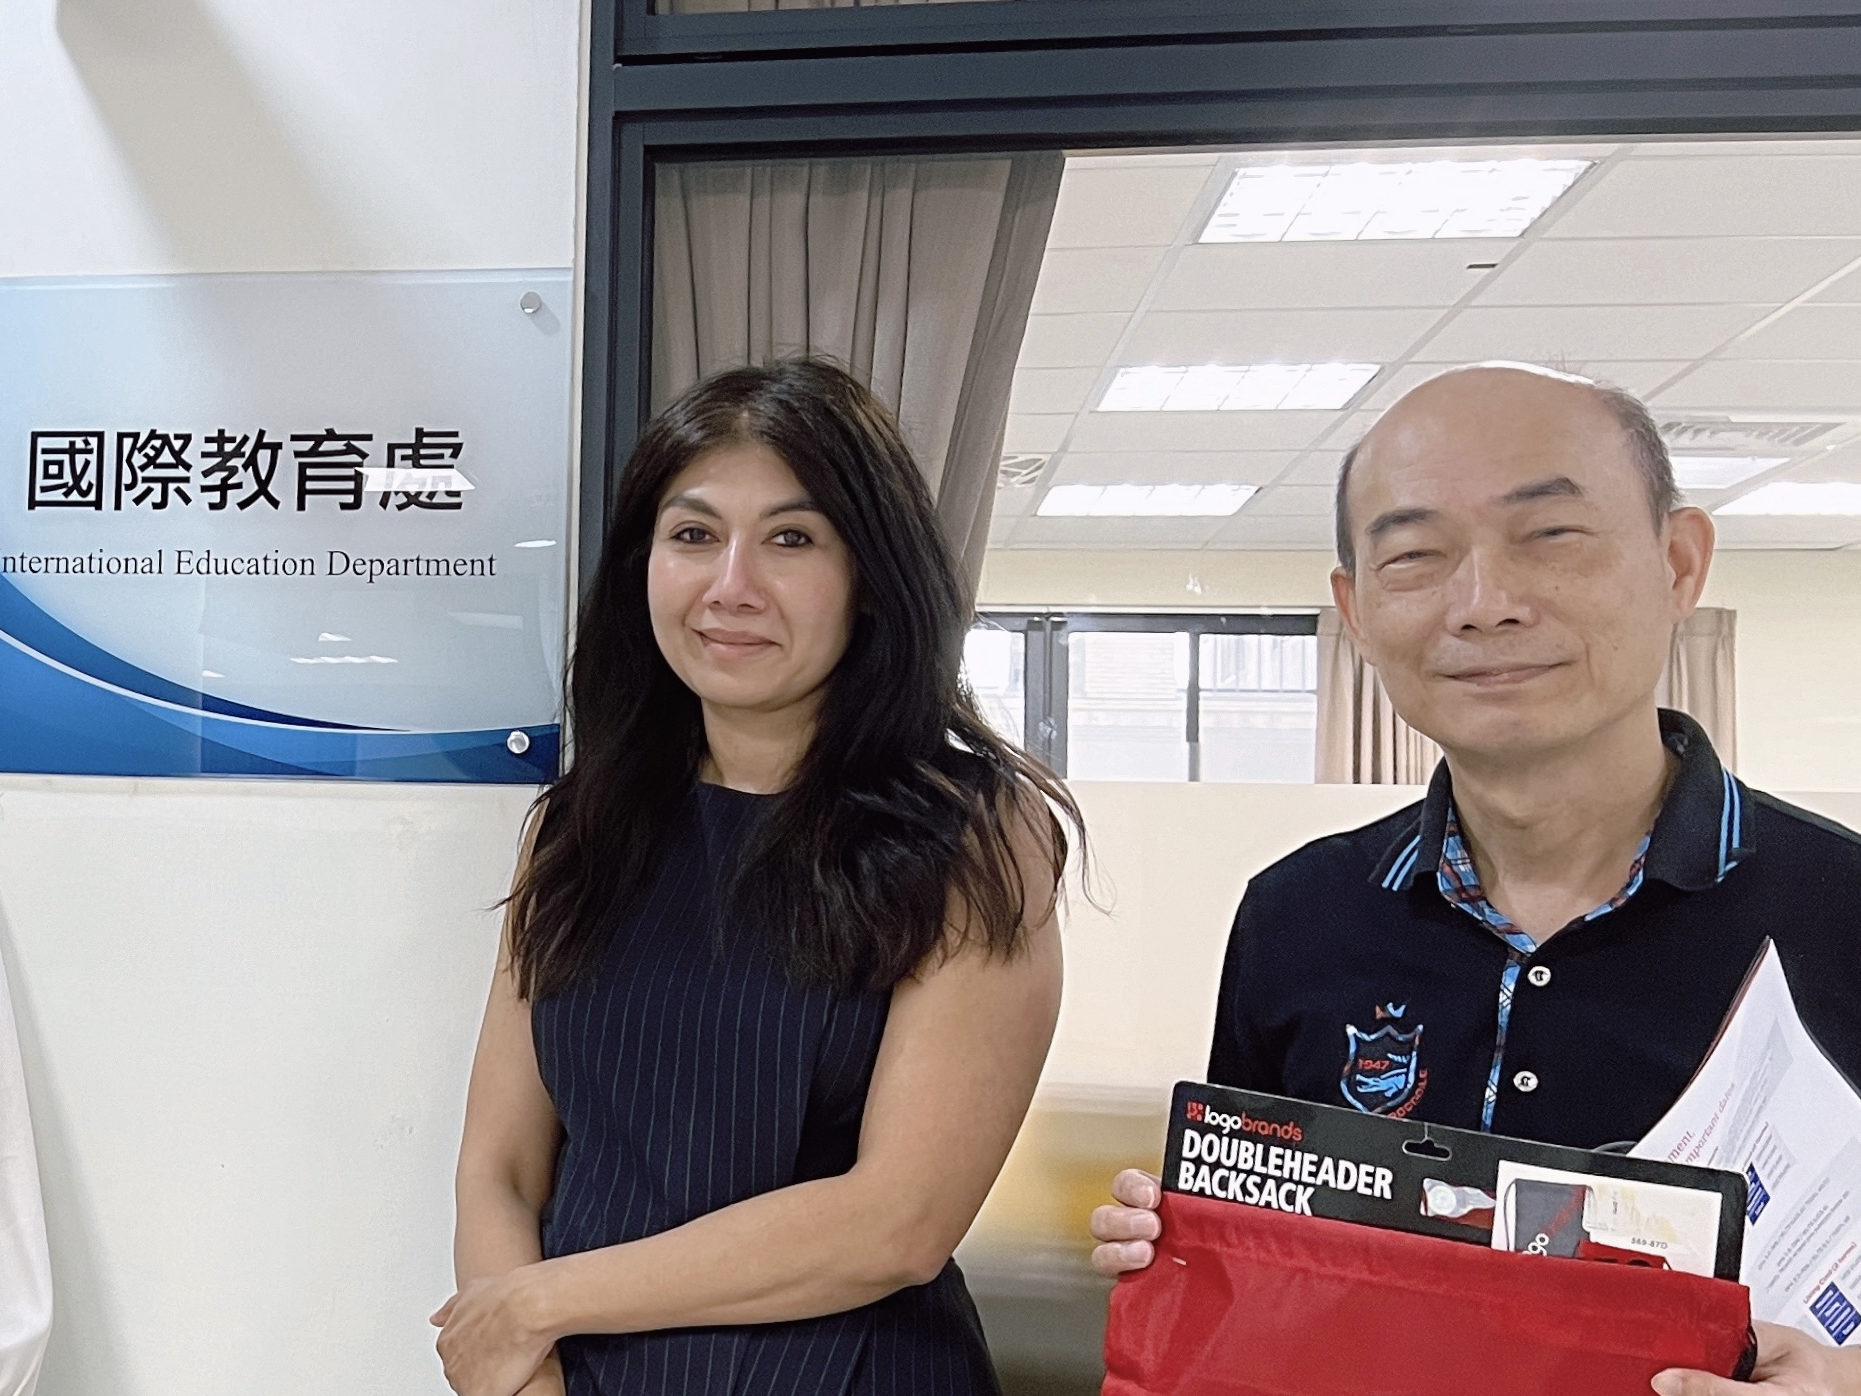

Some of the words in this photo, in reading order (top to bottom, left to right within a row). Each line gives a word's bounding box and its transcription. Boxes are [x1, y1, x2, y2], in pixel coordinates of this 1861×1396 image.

[26, 427, 464, 512] 國際教育處
[175, 549, 316, 577] Education
[326, 549, 497, 584] Department
[1204, 1105, 1303, 1142] logobrands
[1685, 1112, 1719, 1165] mportant
[1178, 1161, 1315, 1216] BACKSACK
[1182, 1128, 1393, 1199] DOUBLEHEADER
